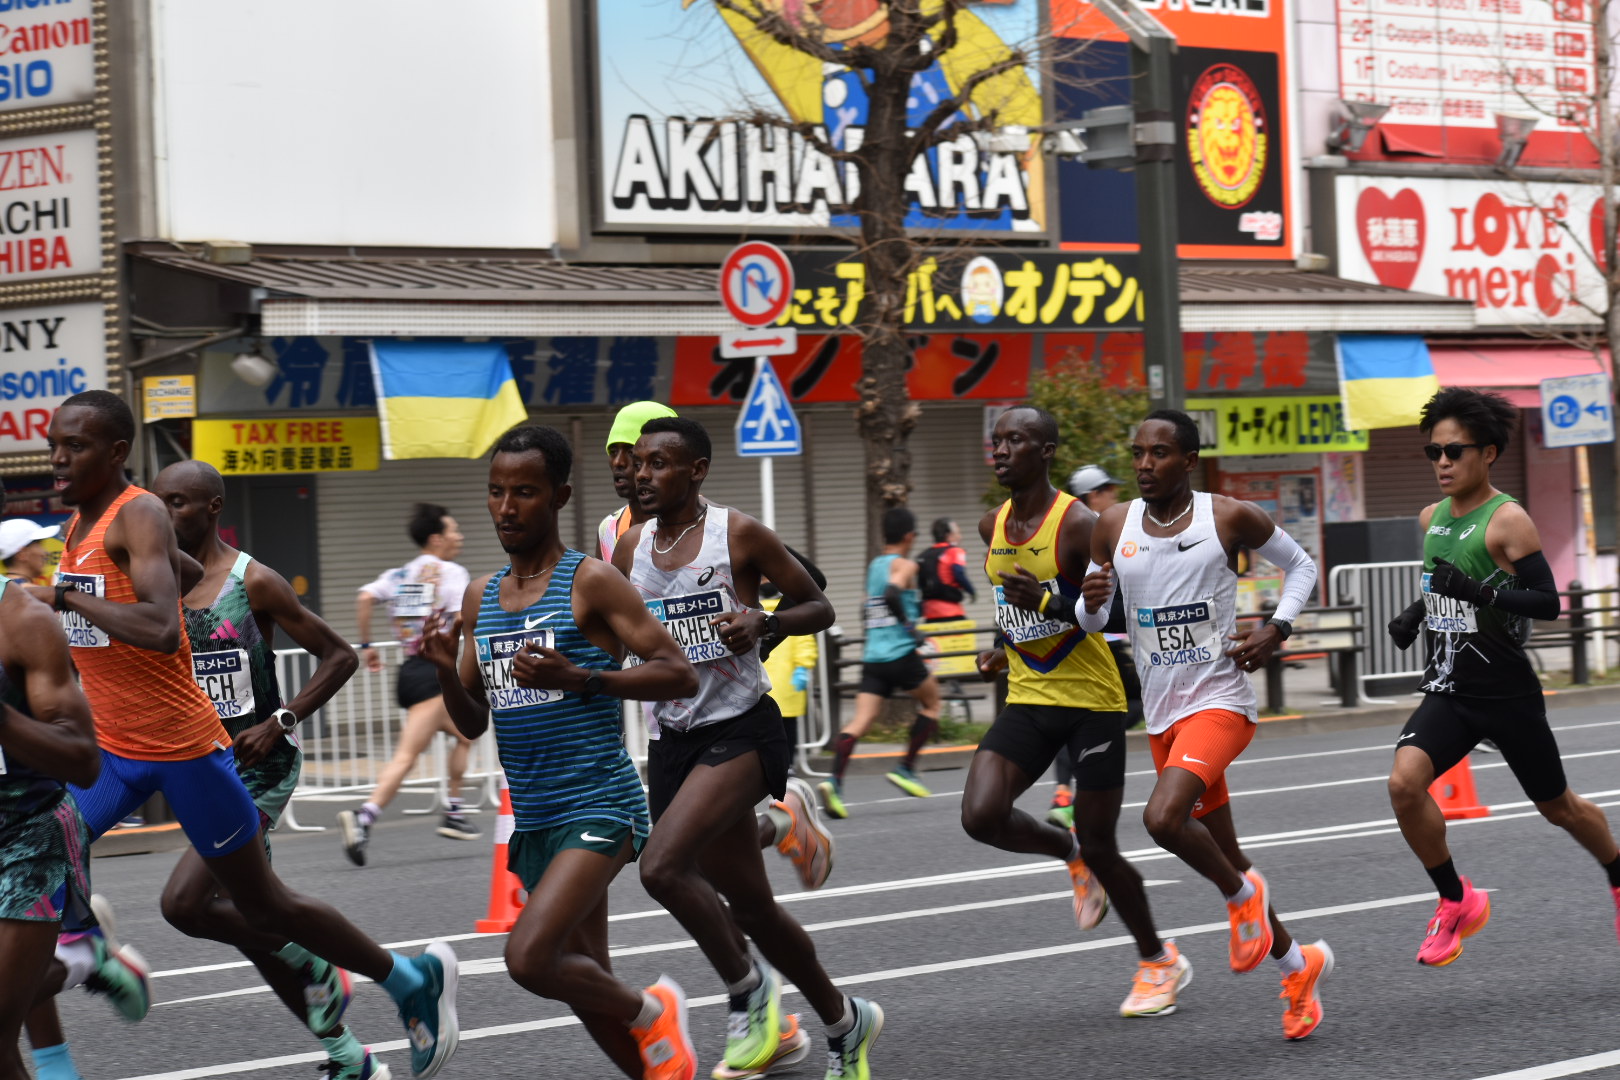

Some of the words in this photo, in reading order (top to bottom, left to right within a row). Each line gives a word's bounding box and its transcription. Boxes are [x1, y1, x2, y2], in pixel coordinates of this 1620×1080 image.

[0, 358, 87, 400] sonic
[232, 422, 280, 445] TAX
[287, 420, 344, 443] FREE
[991, 547, 1017, 556] SUZUKI
[666, 597, 719, 615] 東京メトロ
[1156, 607, 1205, 622] 東京メトロ
[1157, 625, 1196, 651] ESA
